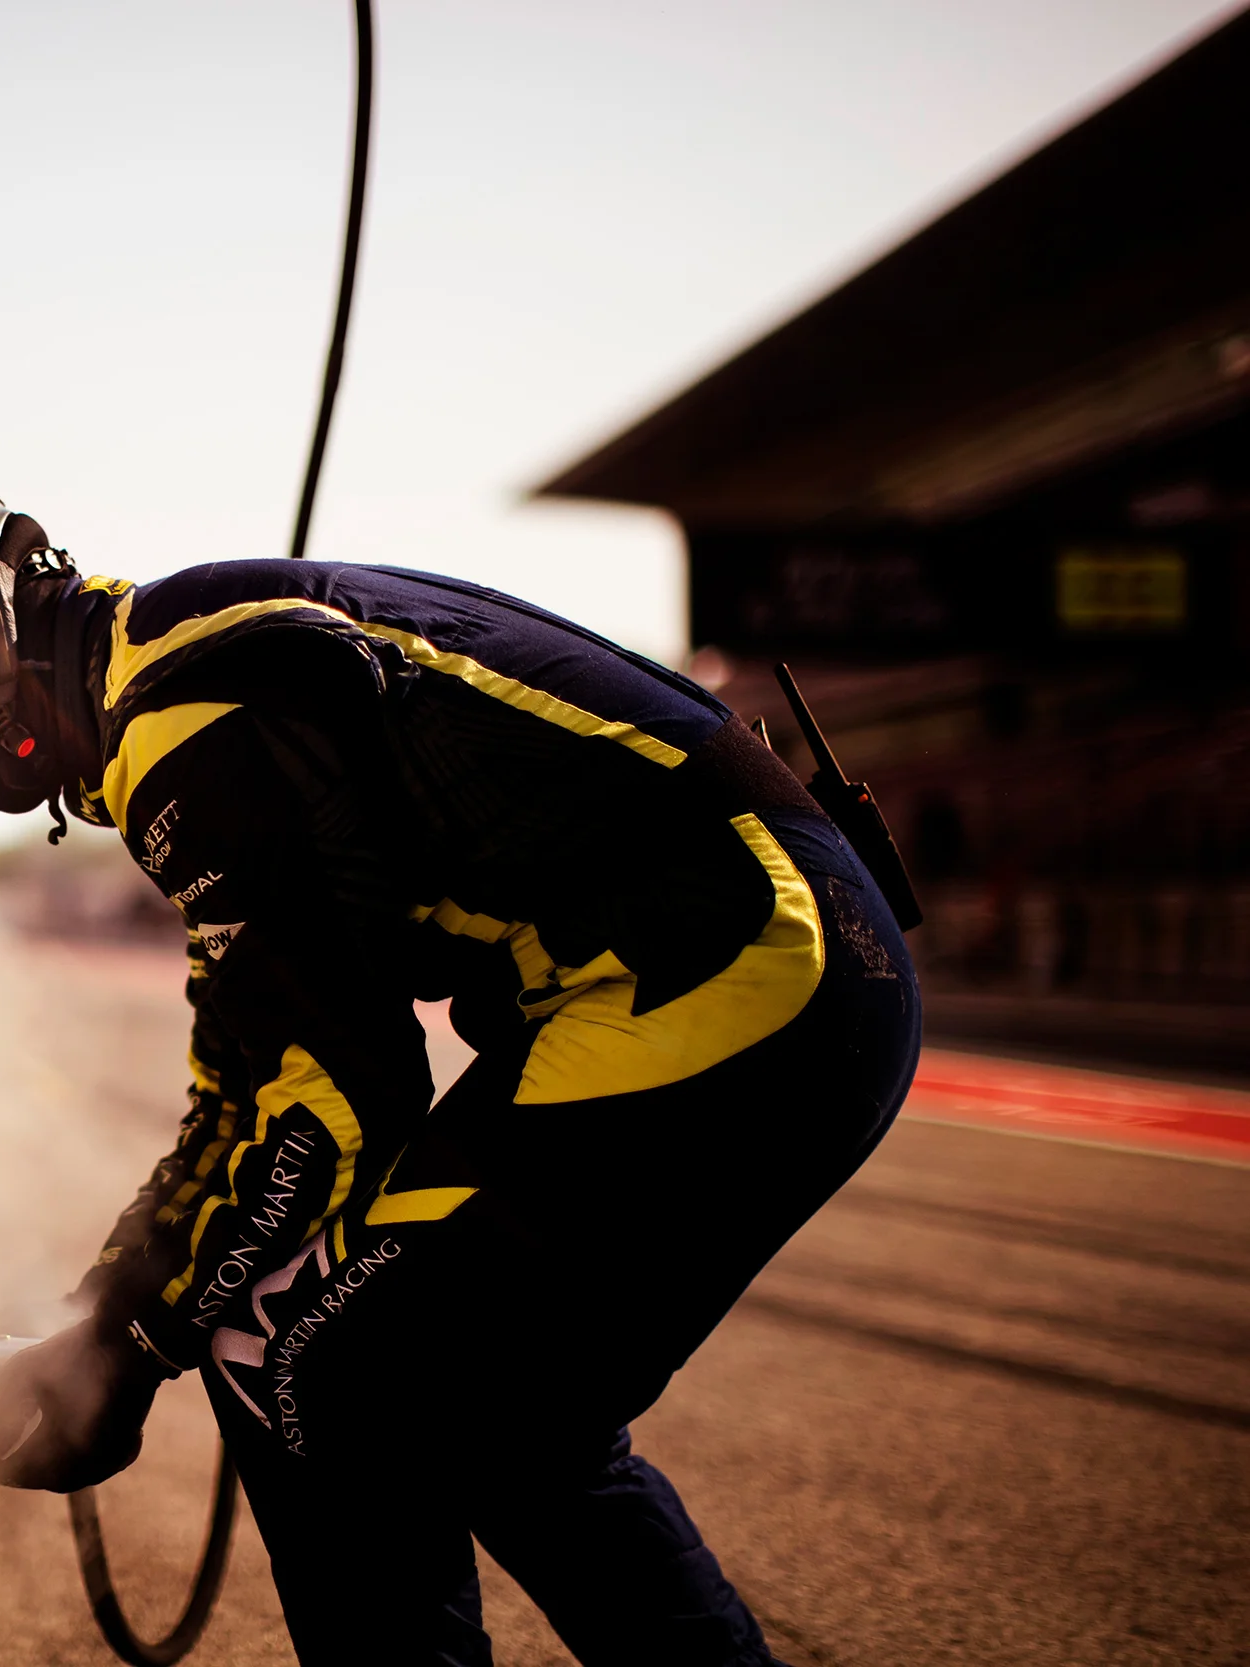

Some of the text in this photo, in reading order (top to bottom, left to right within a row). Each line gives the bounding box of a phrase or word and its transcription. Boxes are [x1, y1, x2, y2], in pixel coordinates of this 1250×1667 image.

[174, 870, 223, 903] TOTAL
[191, 1234, 262, 1328] ASTON
[274, 1237, 402, 1456] ASTON MARTIN RACING
